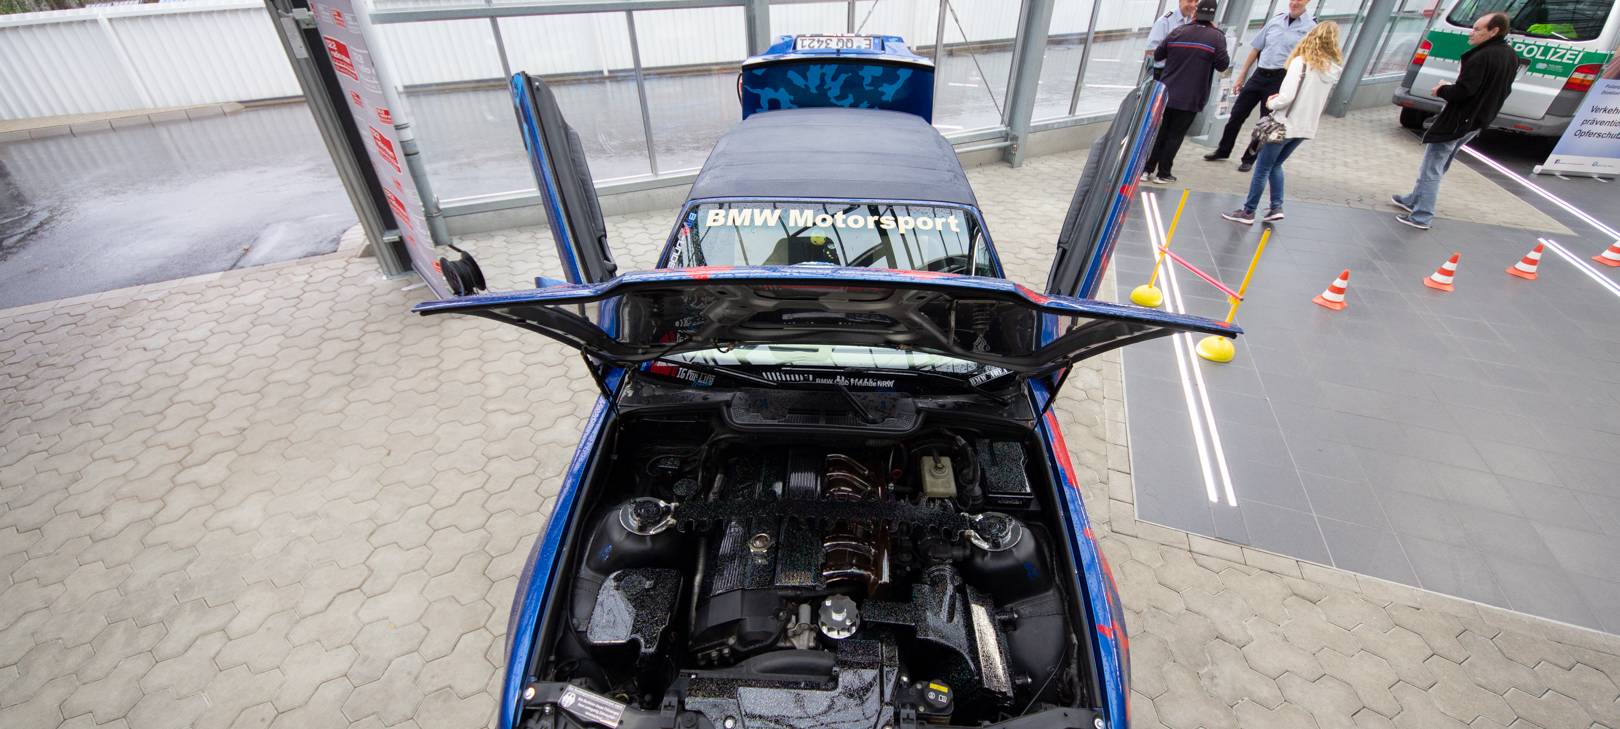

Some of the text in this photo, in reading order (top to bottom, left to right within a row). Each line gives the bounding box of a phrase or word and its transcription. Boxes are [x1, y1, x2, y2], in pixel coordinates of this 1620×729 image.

[800, 38, 832, 49] 3421
[864, 38, 871, 49] E
[1513, 43, 1585, 65] POLIZEI
[1590, 105, 1620, 115] Verkeh
[705, 208, 782, 227] BMW
[789, 208, 960, 234] Motorsport
